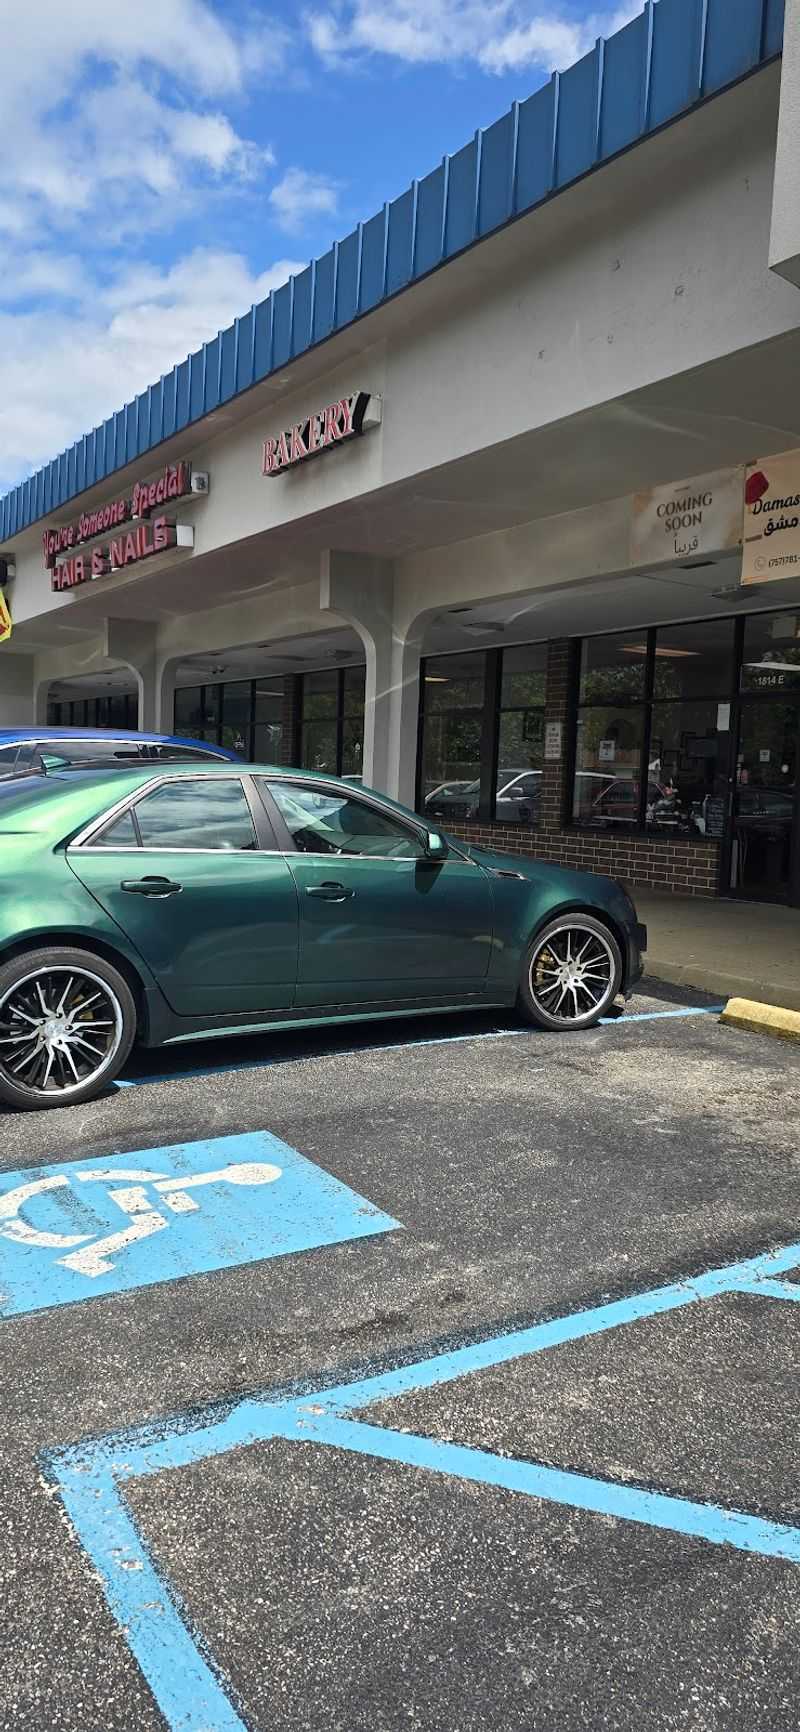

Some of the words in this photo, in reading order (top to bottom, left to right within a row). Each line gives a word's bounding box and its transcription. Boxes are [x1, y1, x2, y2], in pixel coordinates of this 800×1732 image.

[262, 390, 360, 476] BAKERY
[77, 499, 126, 540] Someone
[131, 462, 184, 518] Special
[656, 491, 713, 518] COMING
[664, 511, 703, 533] SOON
[50, 554, 86, 591] HAIR
[109, 514, 169, 567] NAILS
